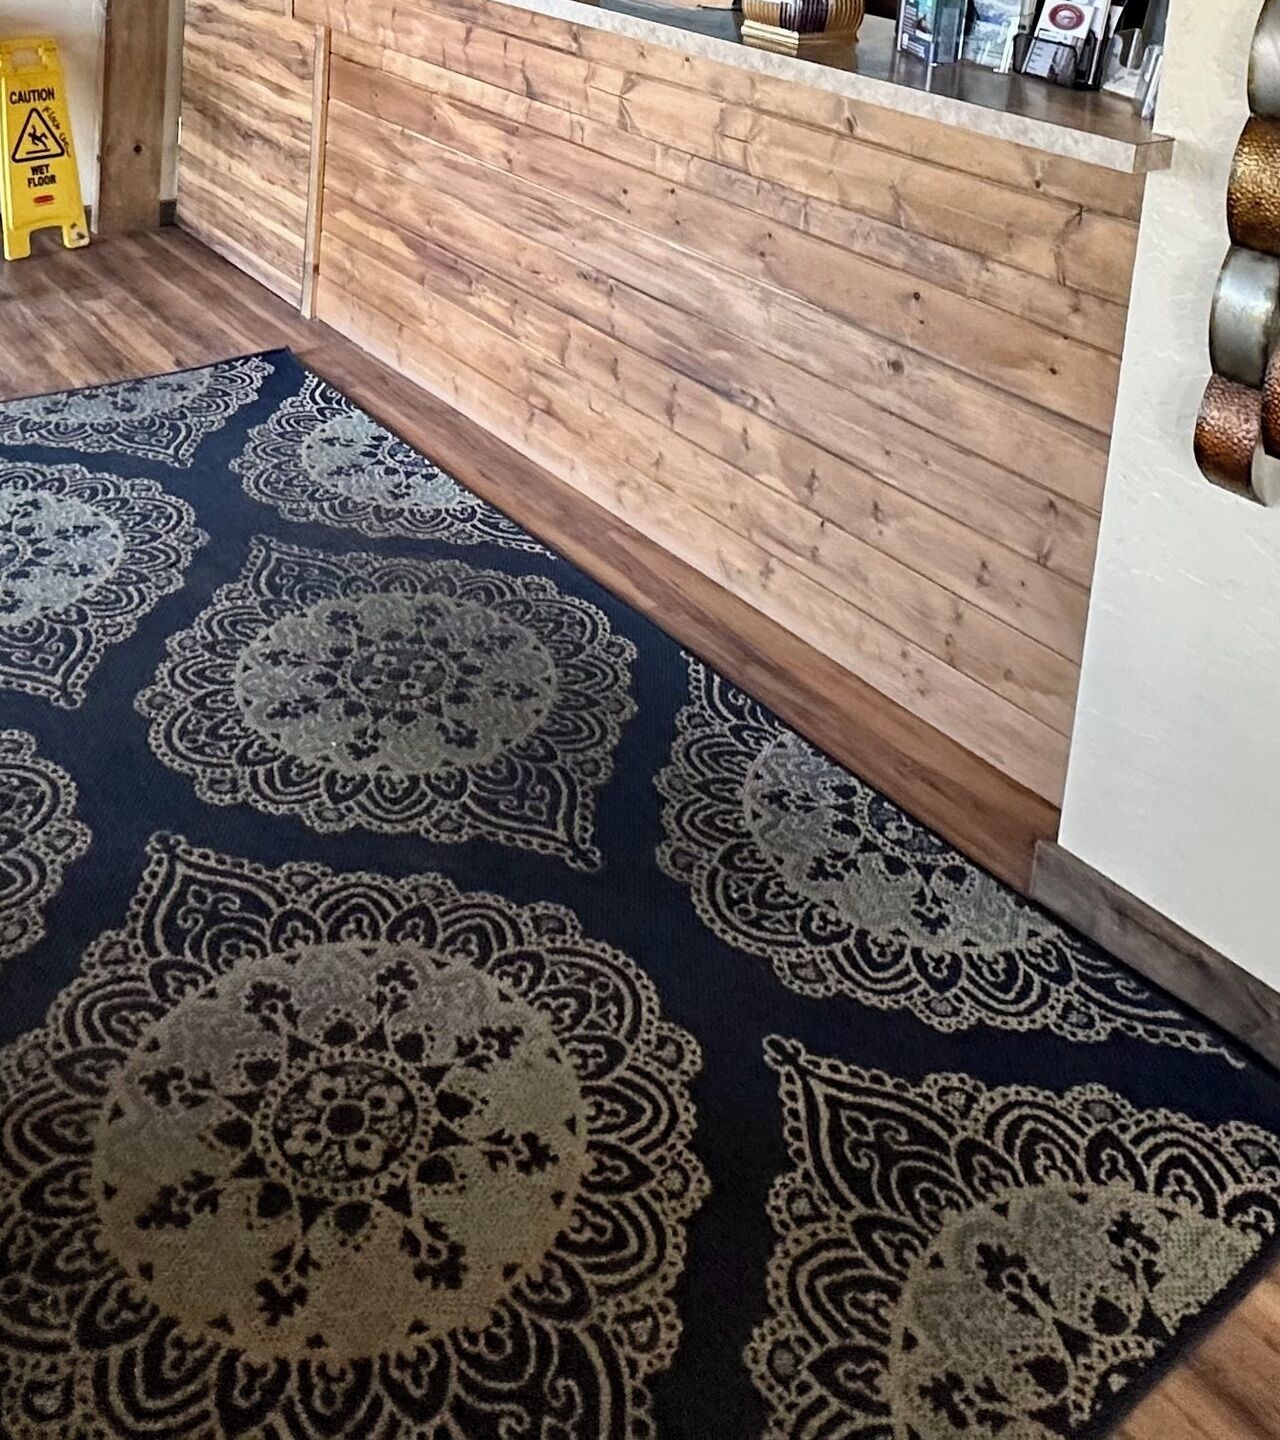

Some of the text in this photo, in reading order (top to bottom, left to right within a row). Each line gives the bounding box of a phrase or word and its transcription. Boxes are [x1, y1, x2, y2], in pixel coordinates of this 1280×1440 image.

[9, 87, 56, 105] CAUTION
[30, 163, 50, 176] WET
[27, 174, 57, 188] FLOOR
